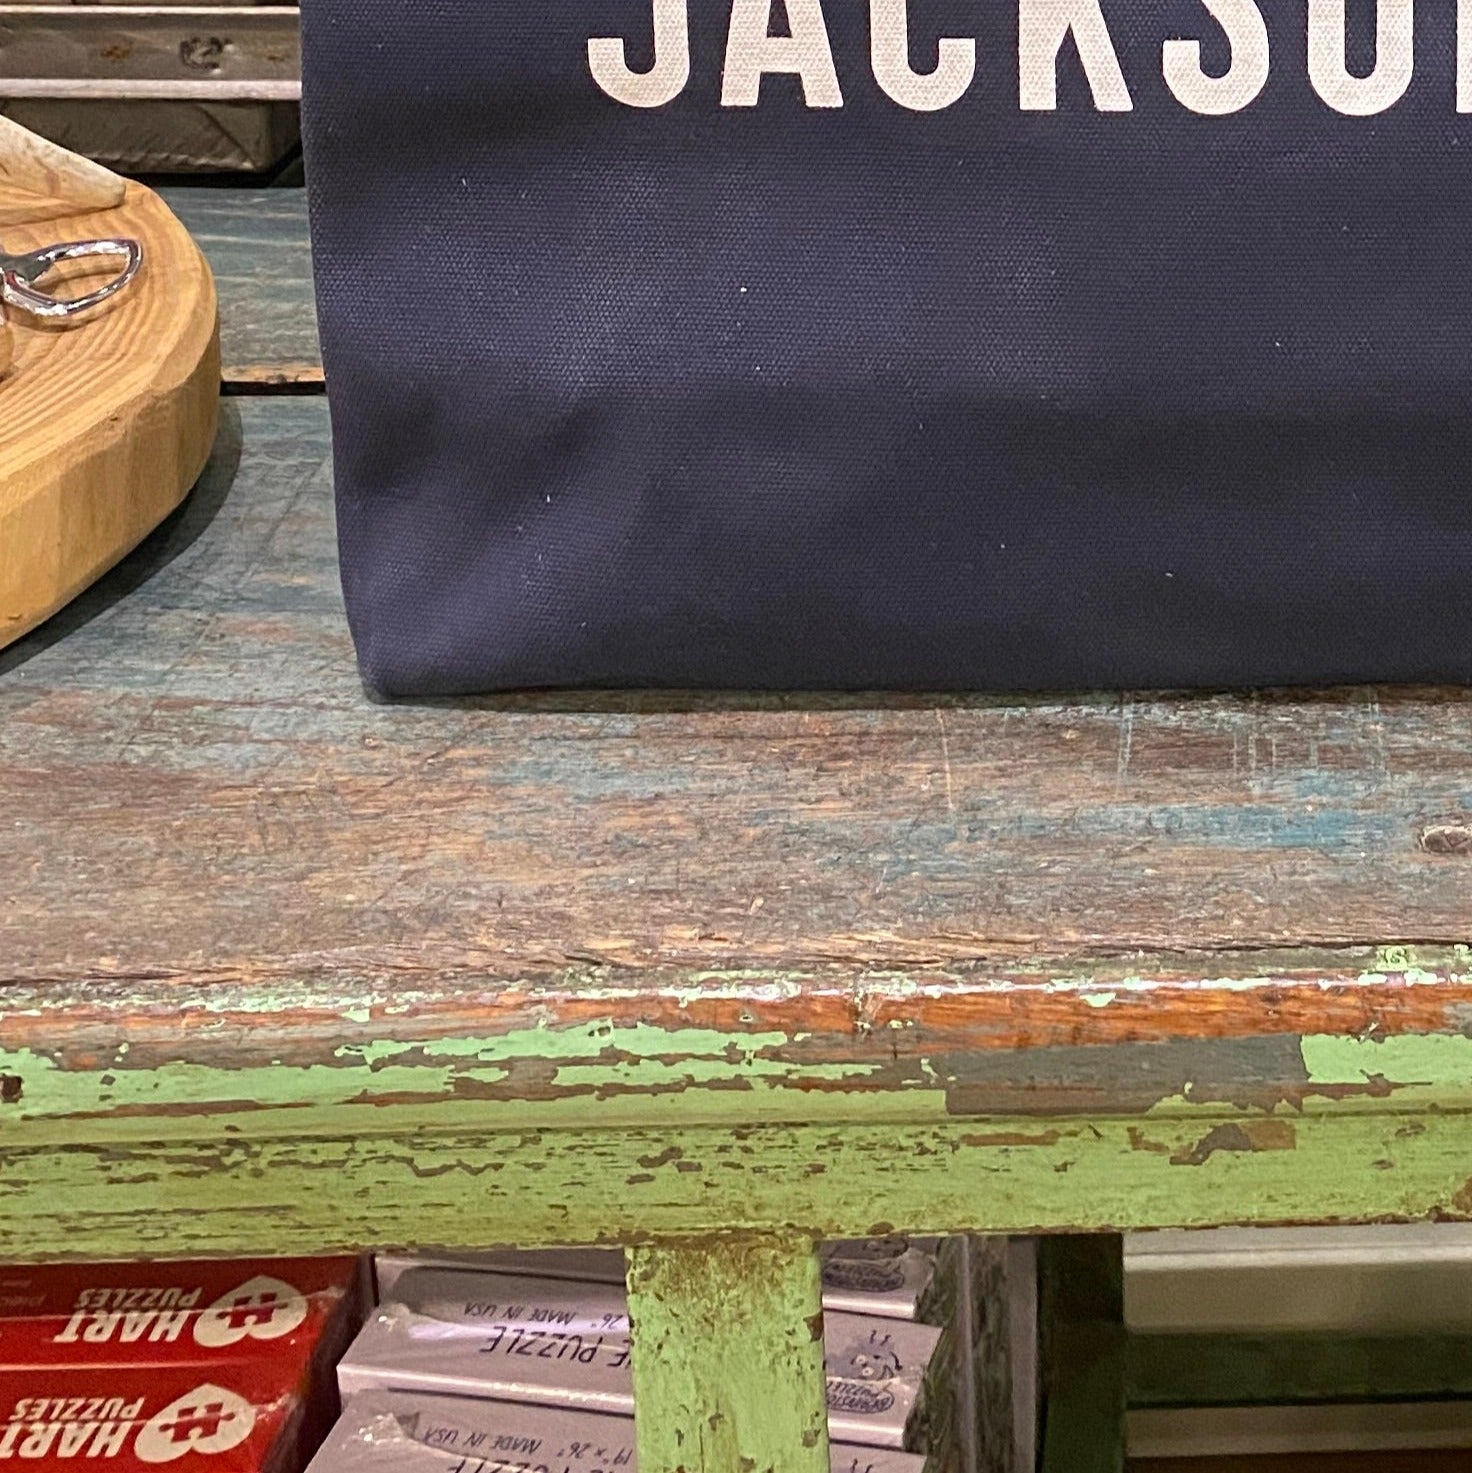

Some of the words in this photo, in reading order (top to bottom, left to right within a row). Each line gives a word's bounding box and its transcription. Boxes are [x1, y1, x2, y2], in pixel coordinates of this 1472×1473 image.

[74, 1286, 202, 1308] PUZZLES
[463, 1303, 497, 1317] USA
[502, 1306, 524, 1320] IN
[528, 1308, 577, 1326] MADE
[52, 1309, 190, 1343] HART
[478, 1325, 604, 1364] PUZZLE
[8, 1397, 145, 1421] PUZZLES
[424, 1428, 459, 1444] USA
[463, 1432, 488, 1447] IN
[492, 1435, 542, 1455] MADE
